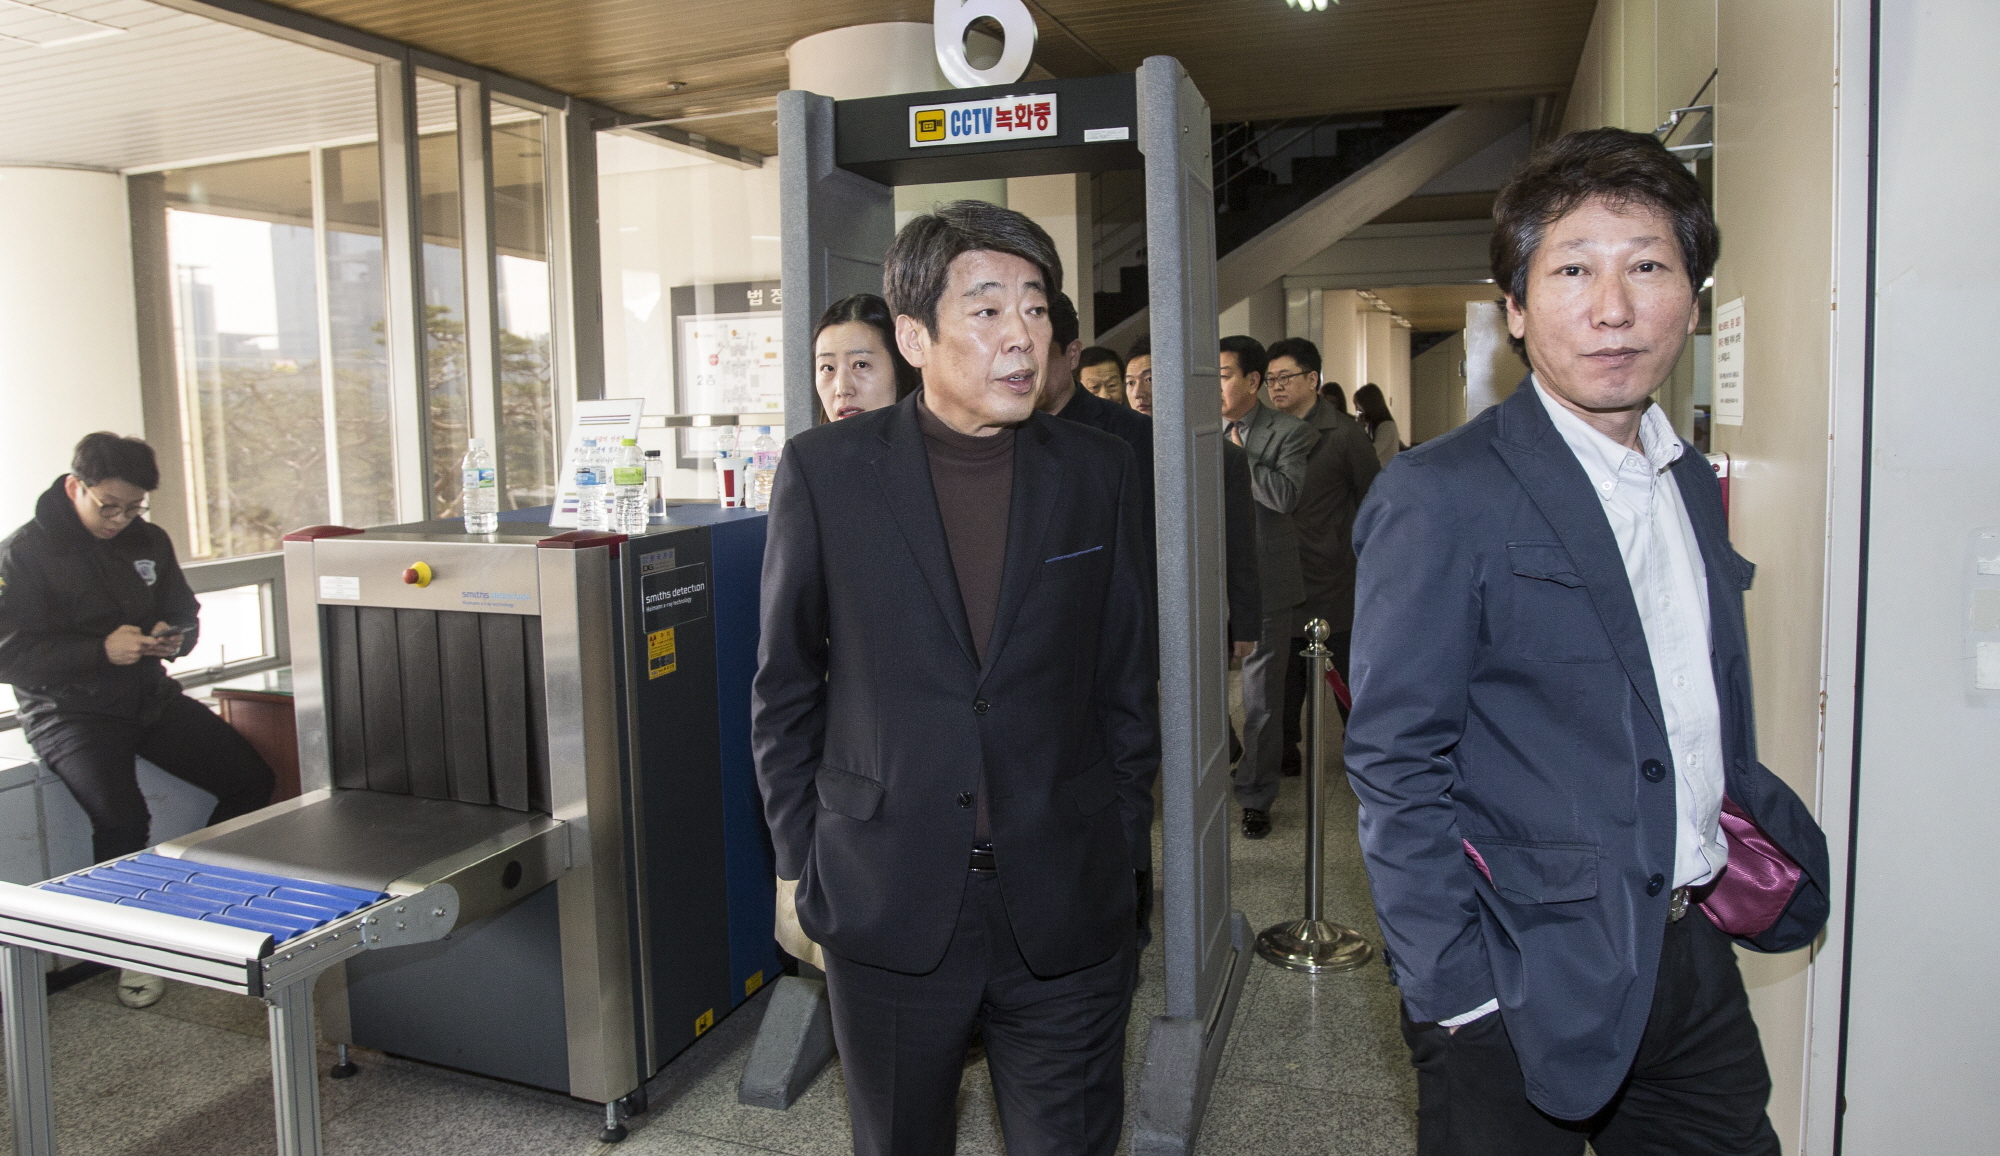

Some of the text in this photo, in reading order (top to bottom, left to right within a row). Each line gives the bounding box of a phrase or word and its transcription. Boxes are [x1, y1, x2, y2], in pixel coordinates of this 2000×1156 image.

[934, 0, 1037, 89] 6
[950, 102, 1052, 137] CCTV 녹화중
[646, 583, 705, 604] smiths detection
